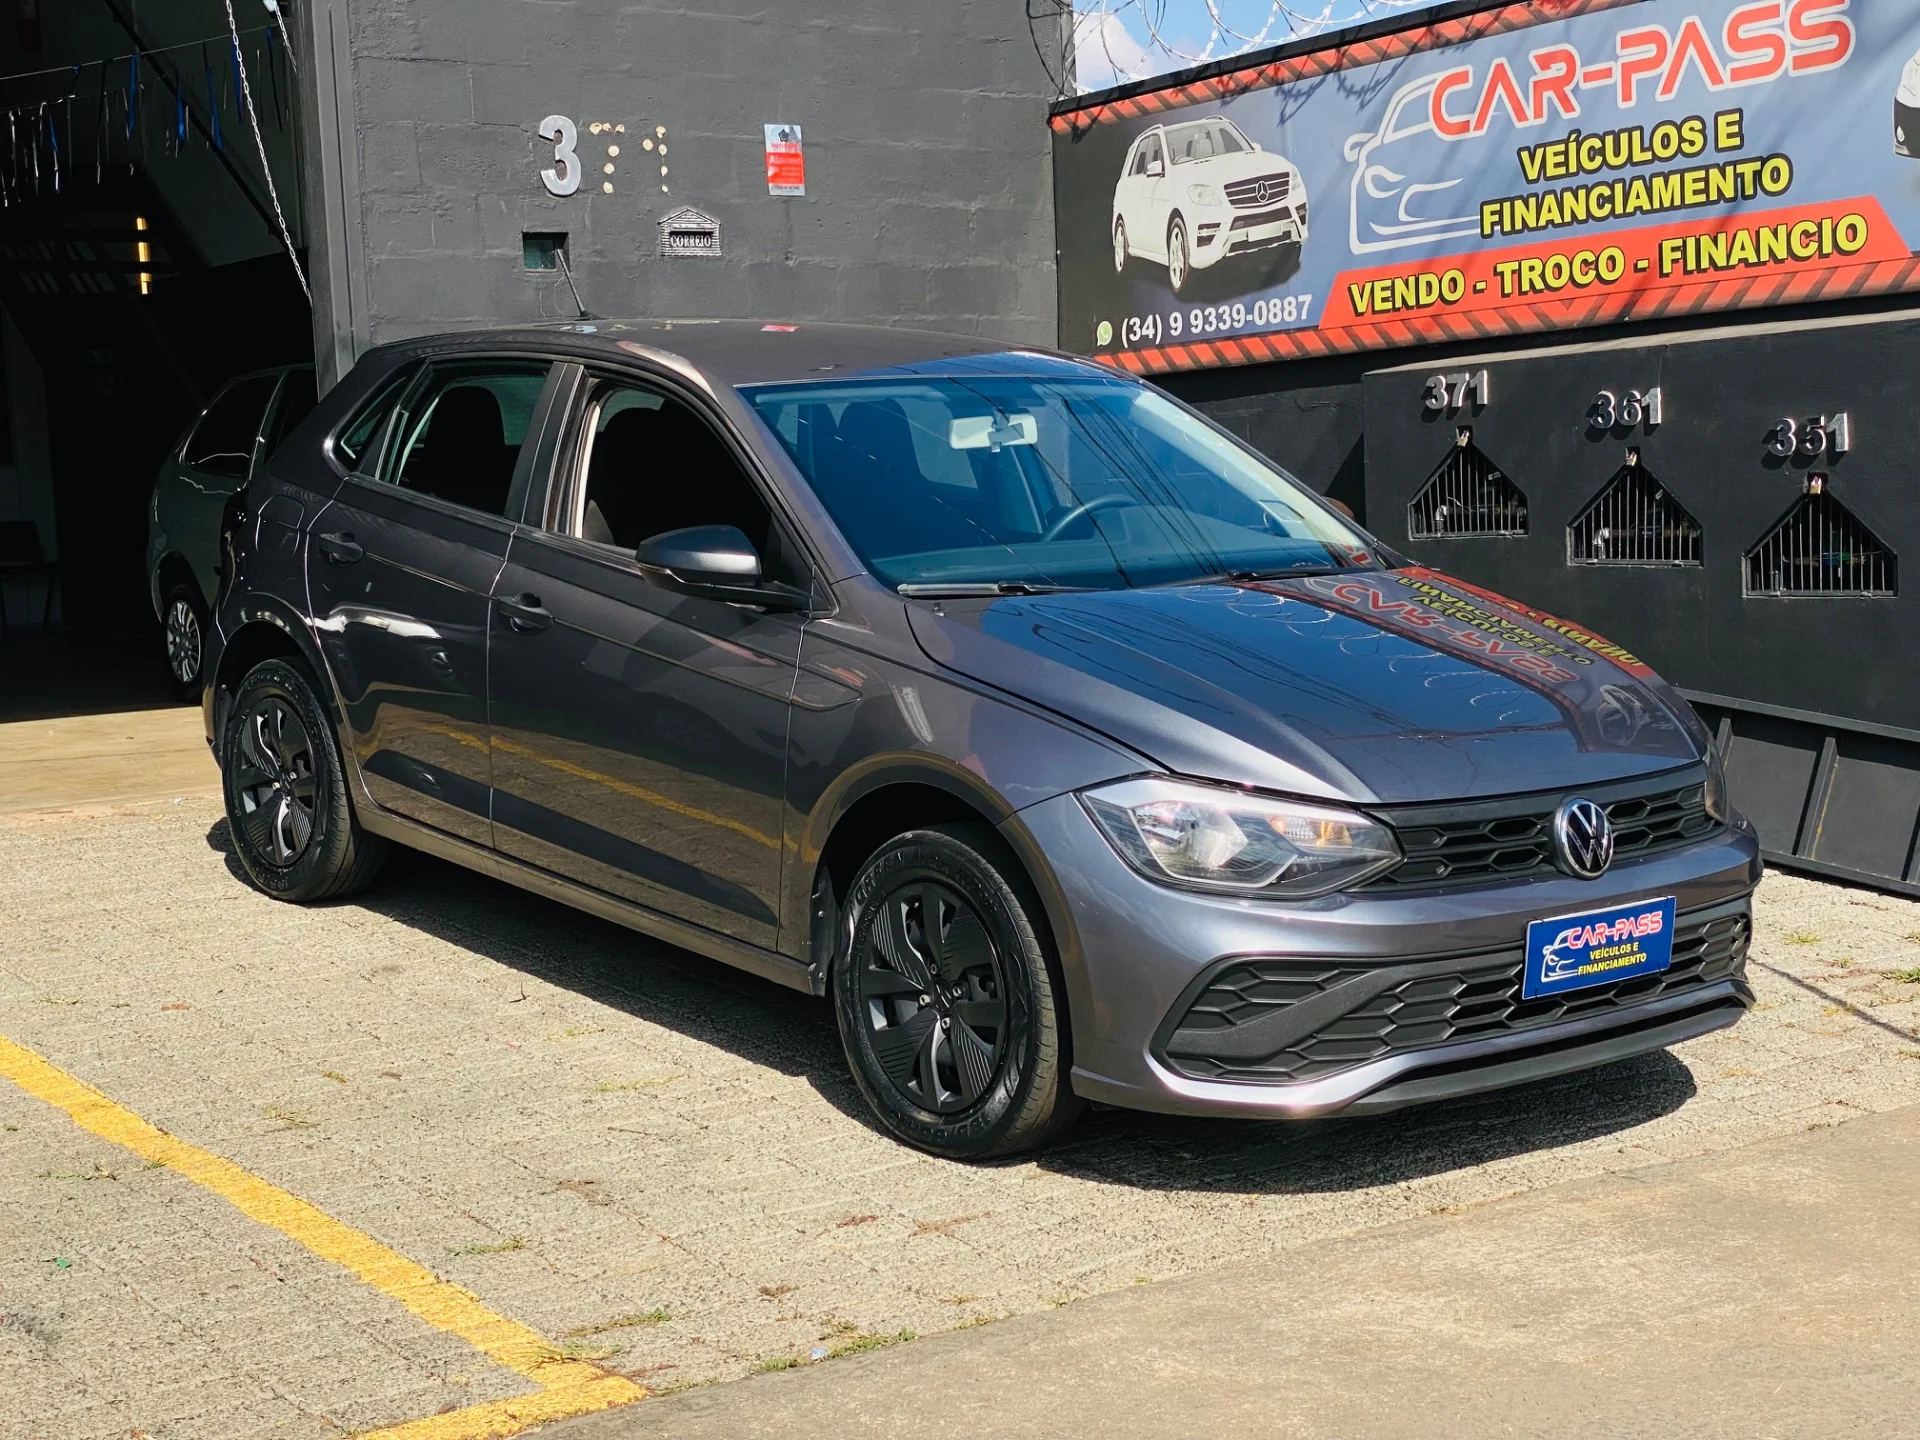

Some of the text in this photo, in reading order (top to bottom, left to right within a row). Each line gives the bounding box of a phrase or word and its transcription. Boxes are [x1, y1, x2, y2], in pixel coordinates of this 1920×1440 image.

[1429, 0, 1855, 139] CAR-PASS
[1518, 110, 1743, 182] VEÍCULOS E
[1481, 156, 1791, 237] FINANCIAMENTO
[669, 234, 712, 248] CORREIO
[1350, 267, 1466, 317] VENDO
[1496, 246, 1625, 295] TROCO
[1659, 213, 1868, 276] FINANCIO
[1121, 293, 1313, 348] (34) 9 9339-0887
[1425, 369, 1488, 410] 371
[1590, 386, 1662, 429] 361
[1769, 411, 1850, 456] 351
[1567, 910, 1663, 949] CAR-PASS
[1589, 941, 1640, 961] VEÍCULOS E
[1577, 952, 1647, 976] FINANCIAMENTO
